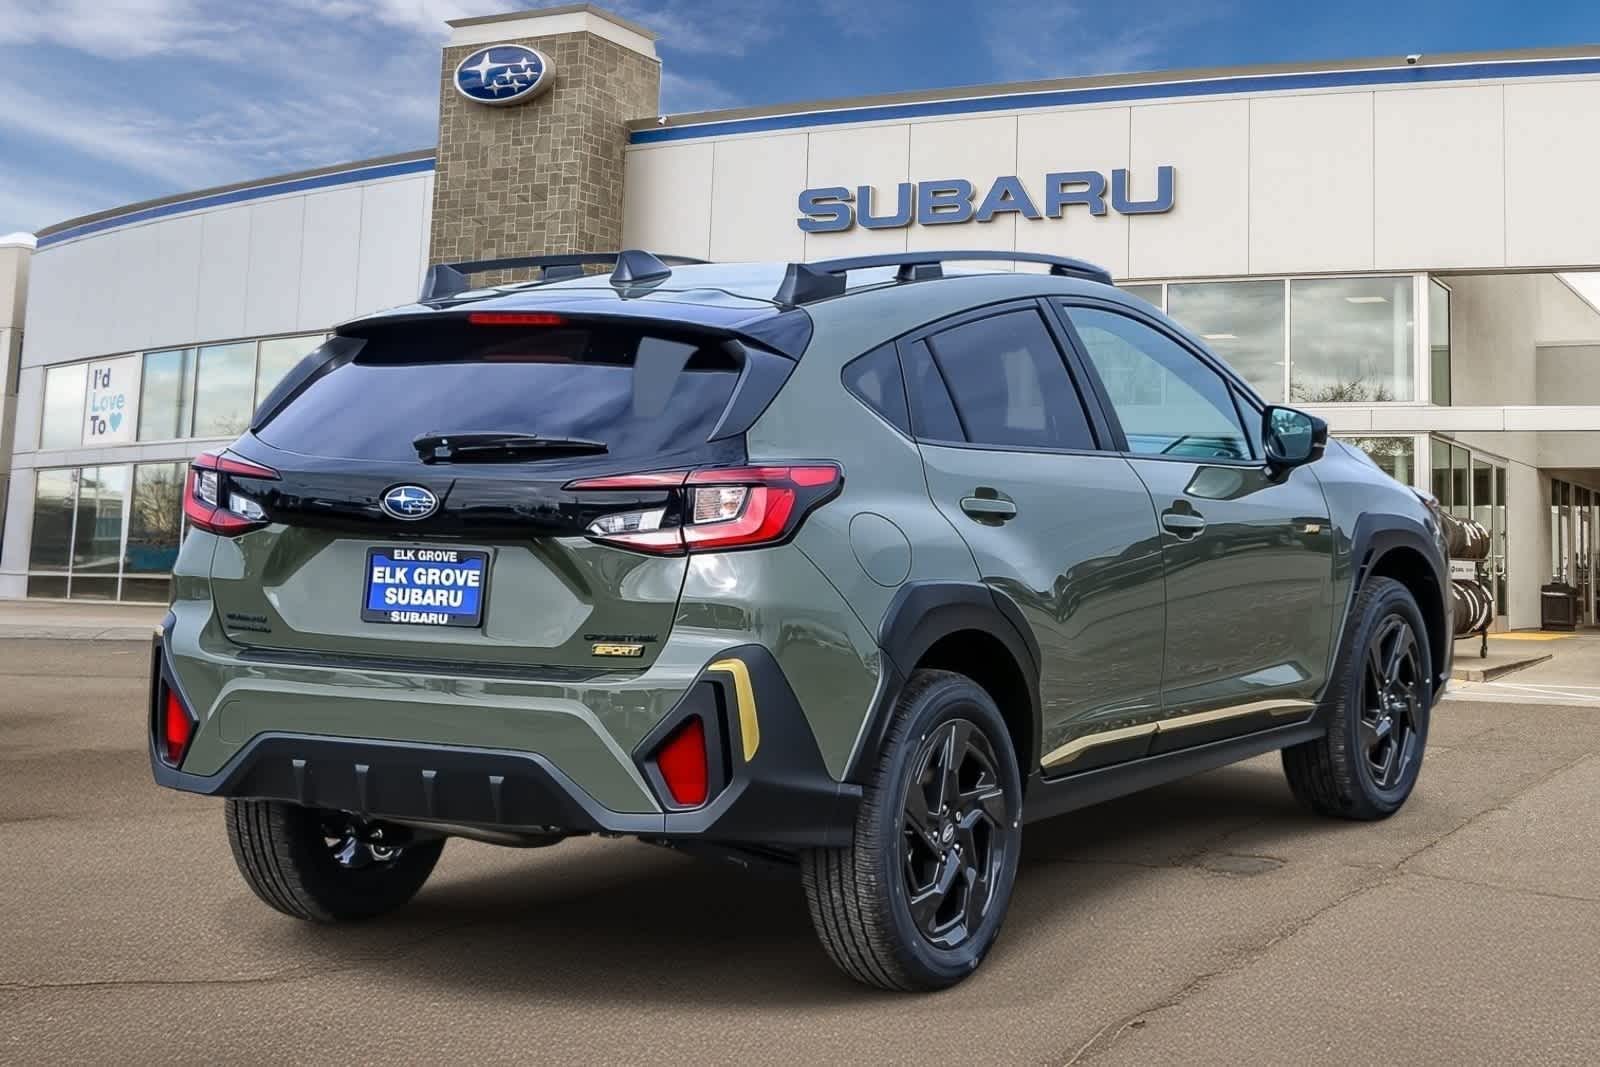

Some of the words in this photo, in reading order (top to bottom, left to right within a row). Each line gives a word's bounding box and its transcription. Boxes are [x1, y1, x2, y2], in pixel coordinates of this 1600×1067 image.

[797, 165, 1176, 233] SUBARU
[93, 367, 111, 389] I'd
[91, 392, 125, 412] Love
[90, 415, 106, 435] To
[394, 549, 417, 560] ELK
[418, 550, 457, 562] GROVE
[372, 566, 409, 584] ELK
[413, 567, 481, 587] GROVE
[384, 587, 463, 607] SUBARU
[391, 611, 448, 624] SUBARU
[594, 645, 641, 656] SPORT
